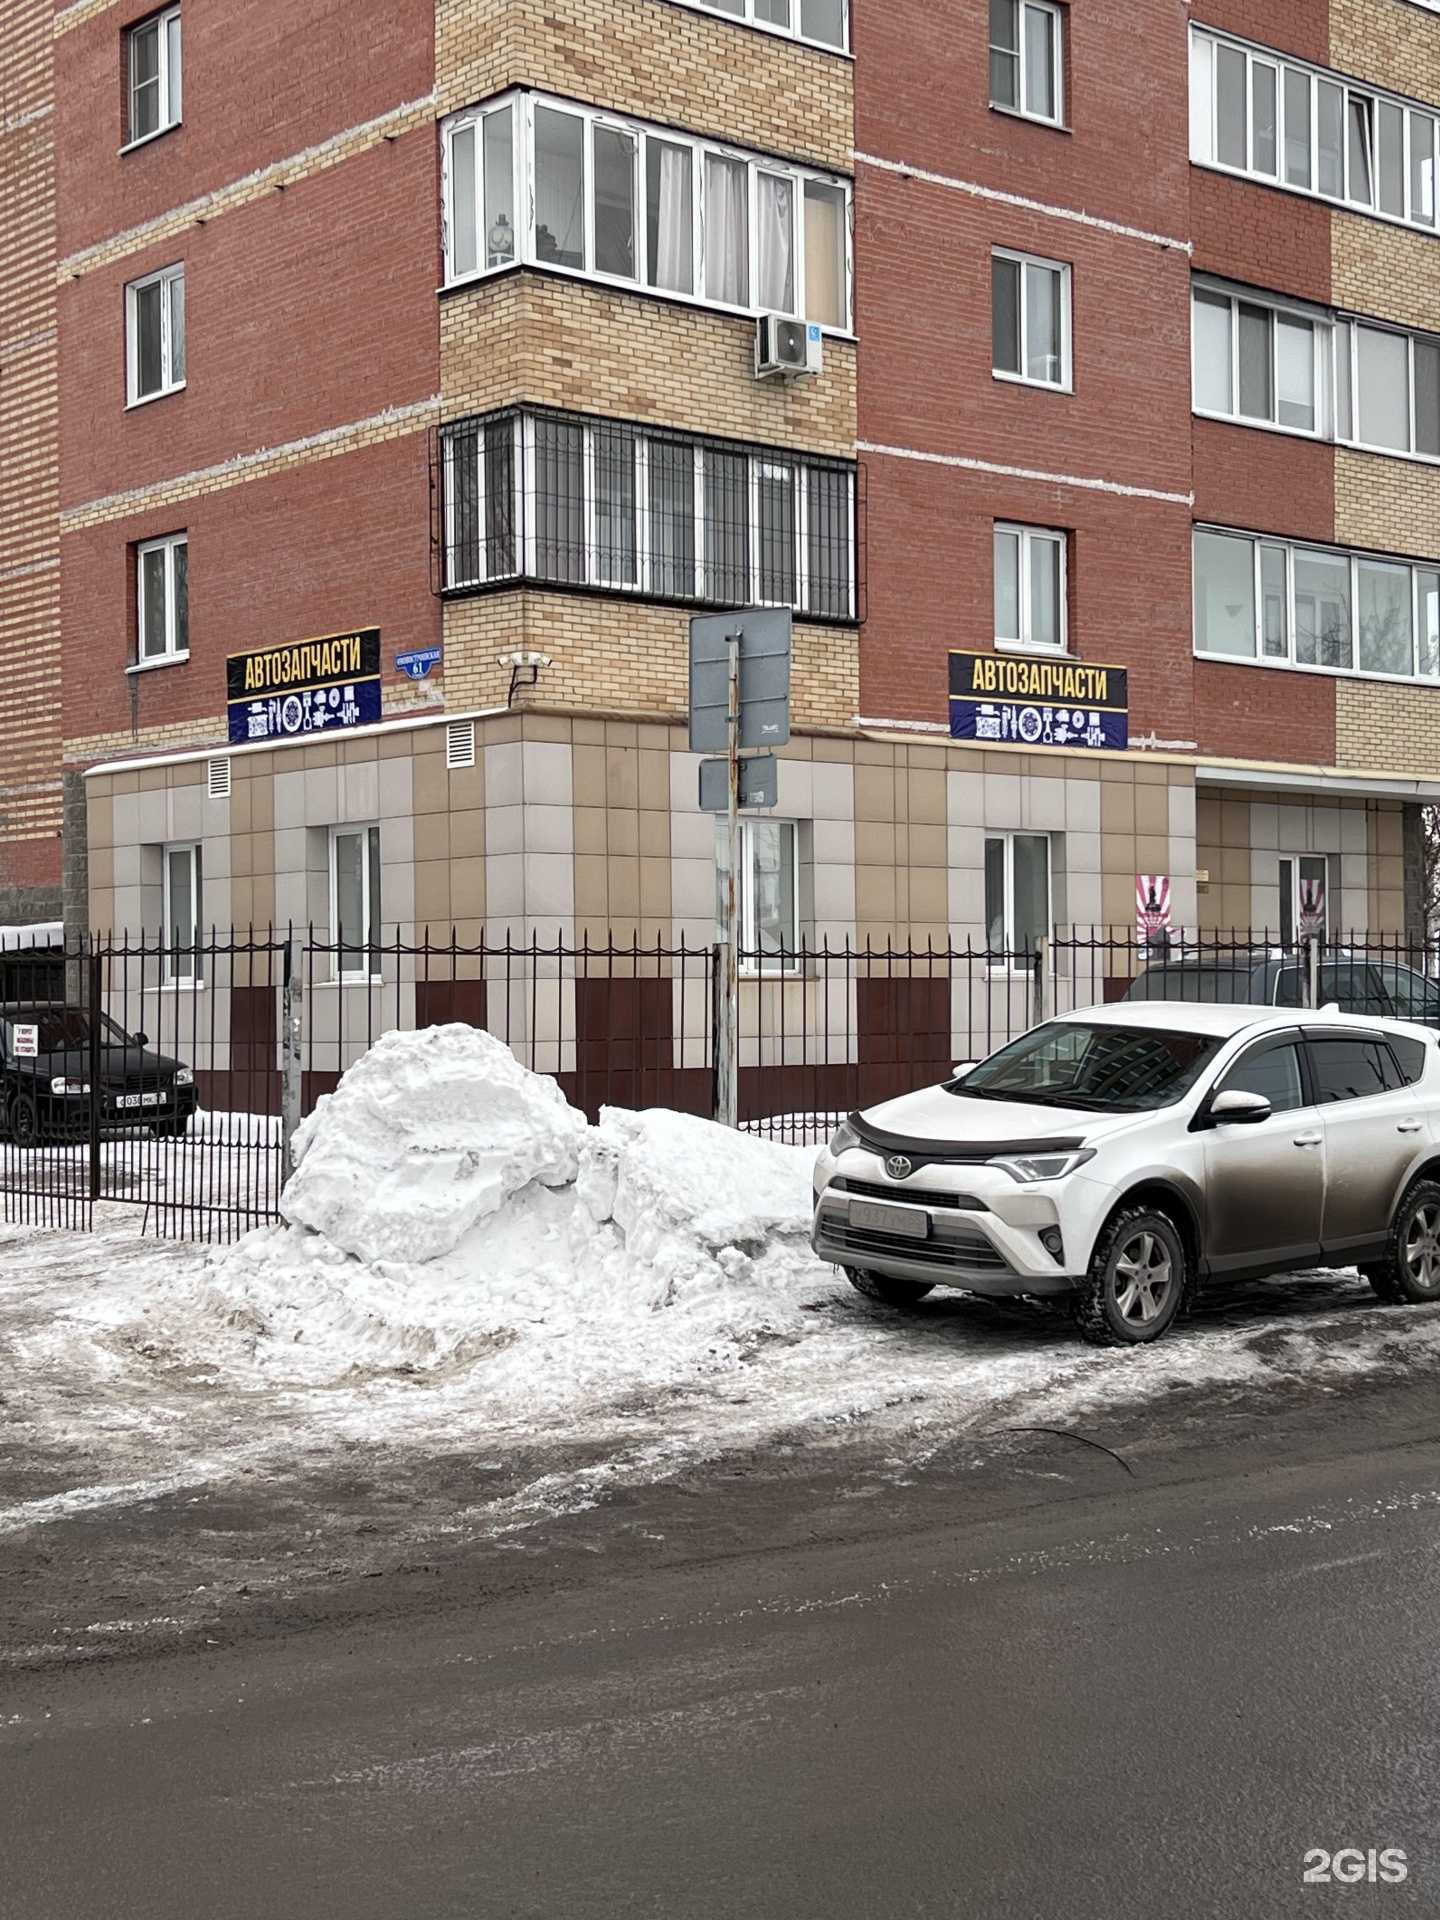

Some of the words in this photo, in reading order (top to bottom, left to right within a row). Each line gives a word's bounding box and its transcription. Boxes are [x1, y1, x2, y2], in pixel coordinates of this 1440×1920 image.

[245, 636, 361, 690] АВТОЗАПЧАСТИ
[412, 661, 423, 674] 61
[972, 658, 1108, 700] АВТОЗАПЧАСТИ
